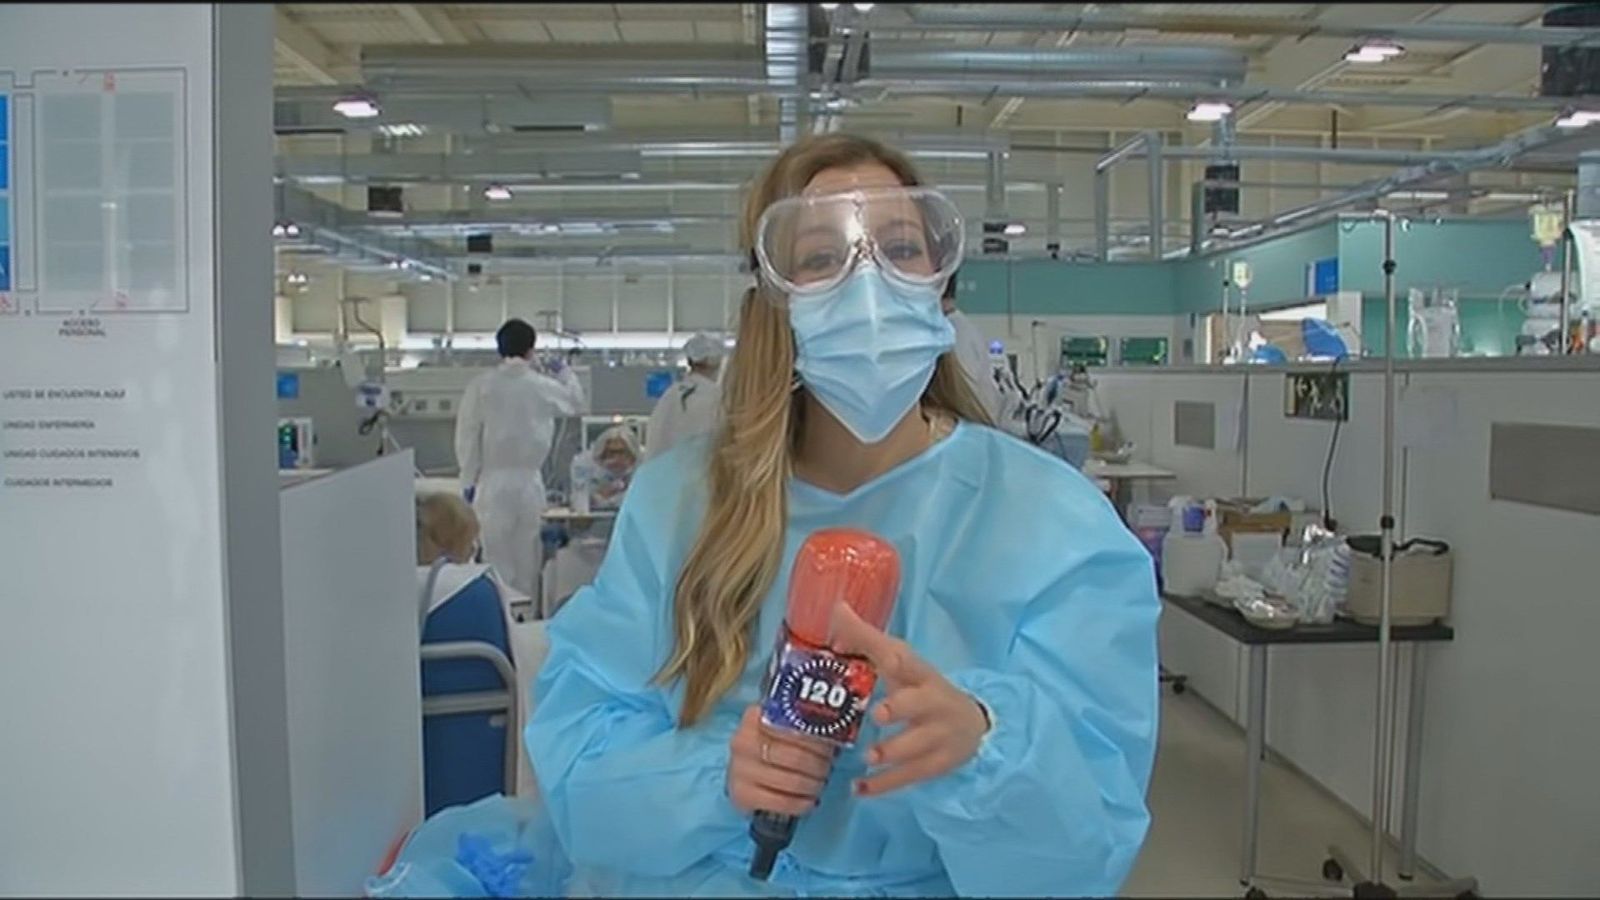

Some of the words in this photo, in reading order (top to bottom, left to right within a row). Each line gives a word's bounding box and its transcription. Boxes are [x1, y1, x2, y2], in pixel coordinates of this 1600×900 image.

[48, 389, 101, 399] ENCUENTRA
[3, 420, 35, 430] UNIDAD
[4, 449, 36, 459] UNIDAD
[40, 449, 85, 459] CUIDADOS
[88, 449, 140, 459] INTENSIVOS
[4, 478, 49, 488] CUIDADOS
[53, 478, 113, 488] INTERMEDIOS
[799, 676, 847, 708] 120
